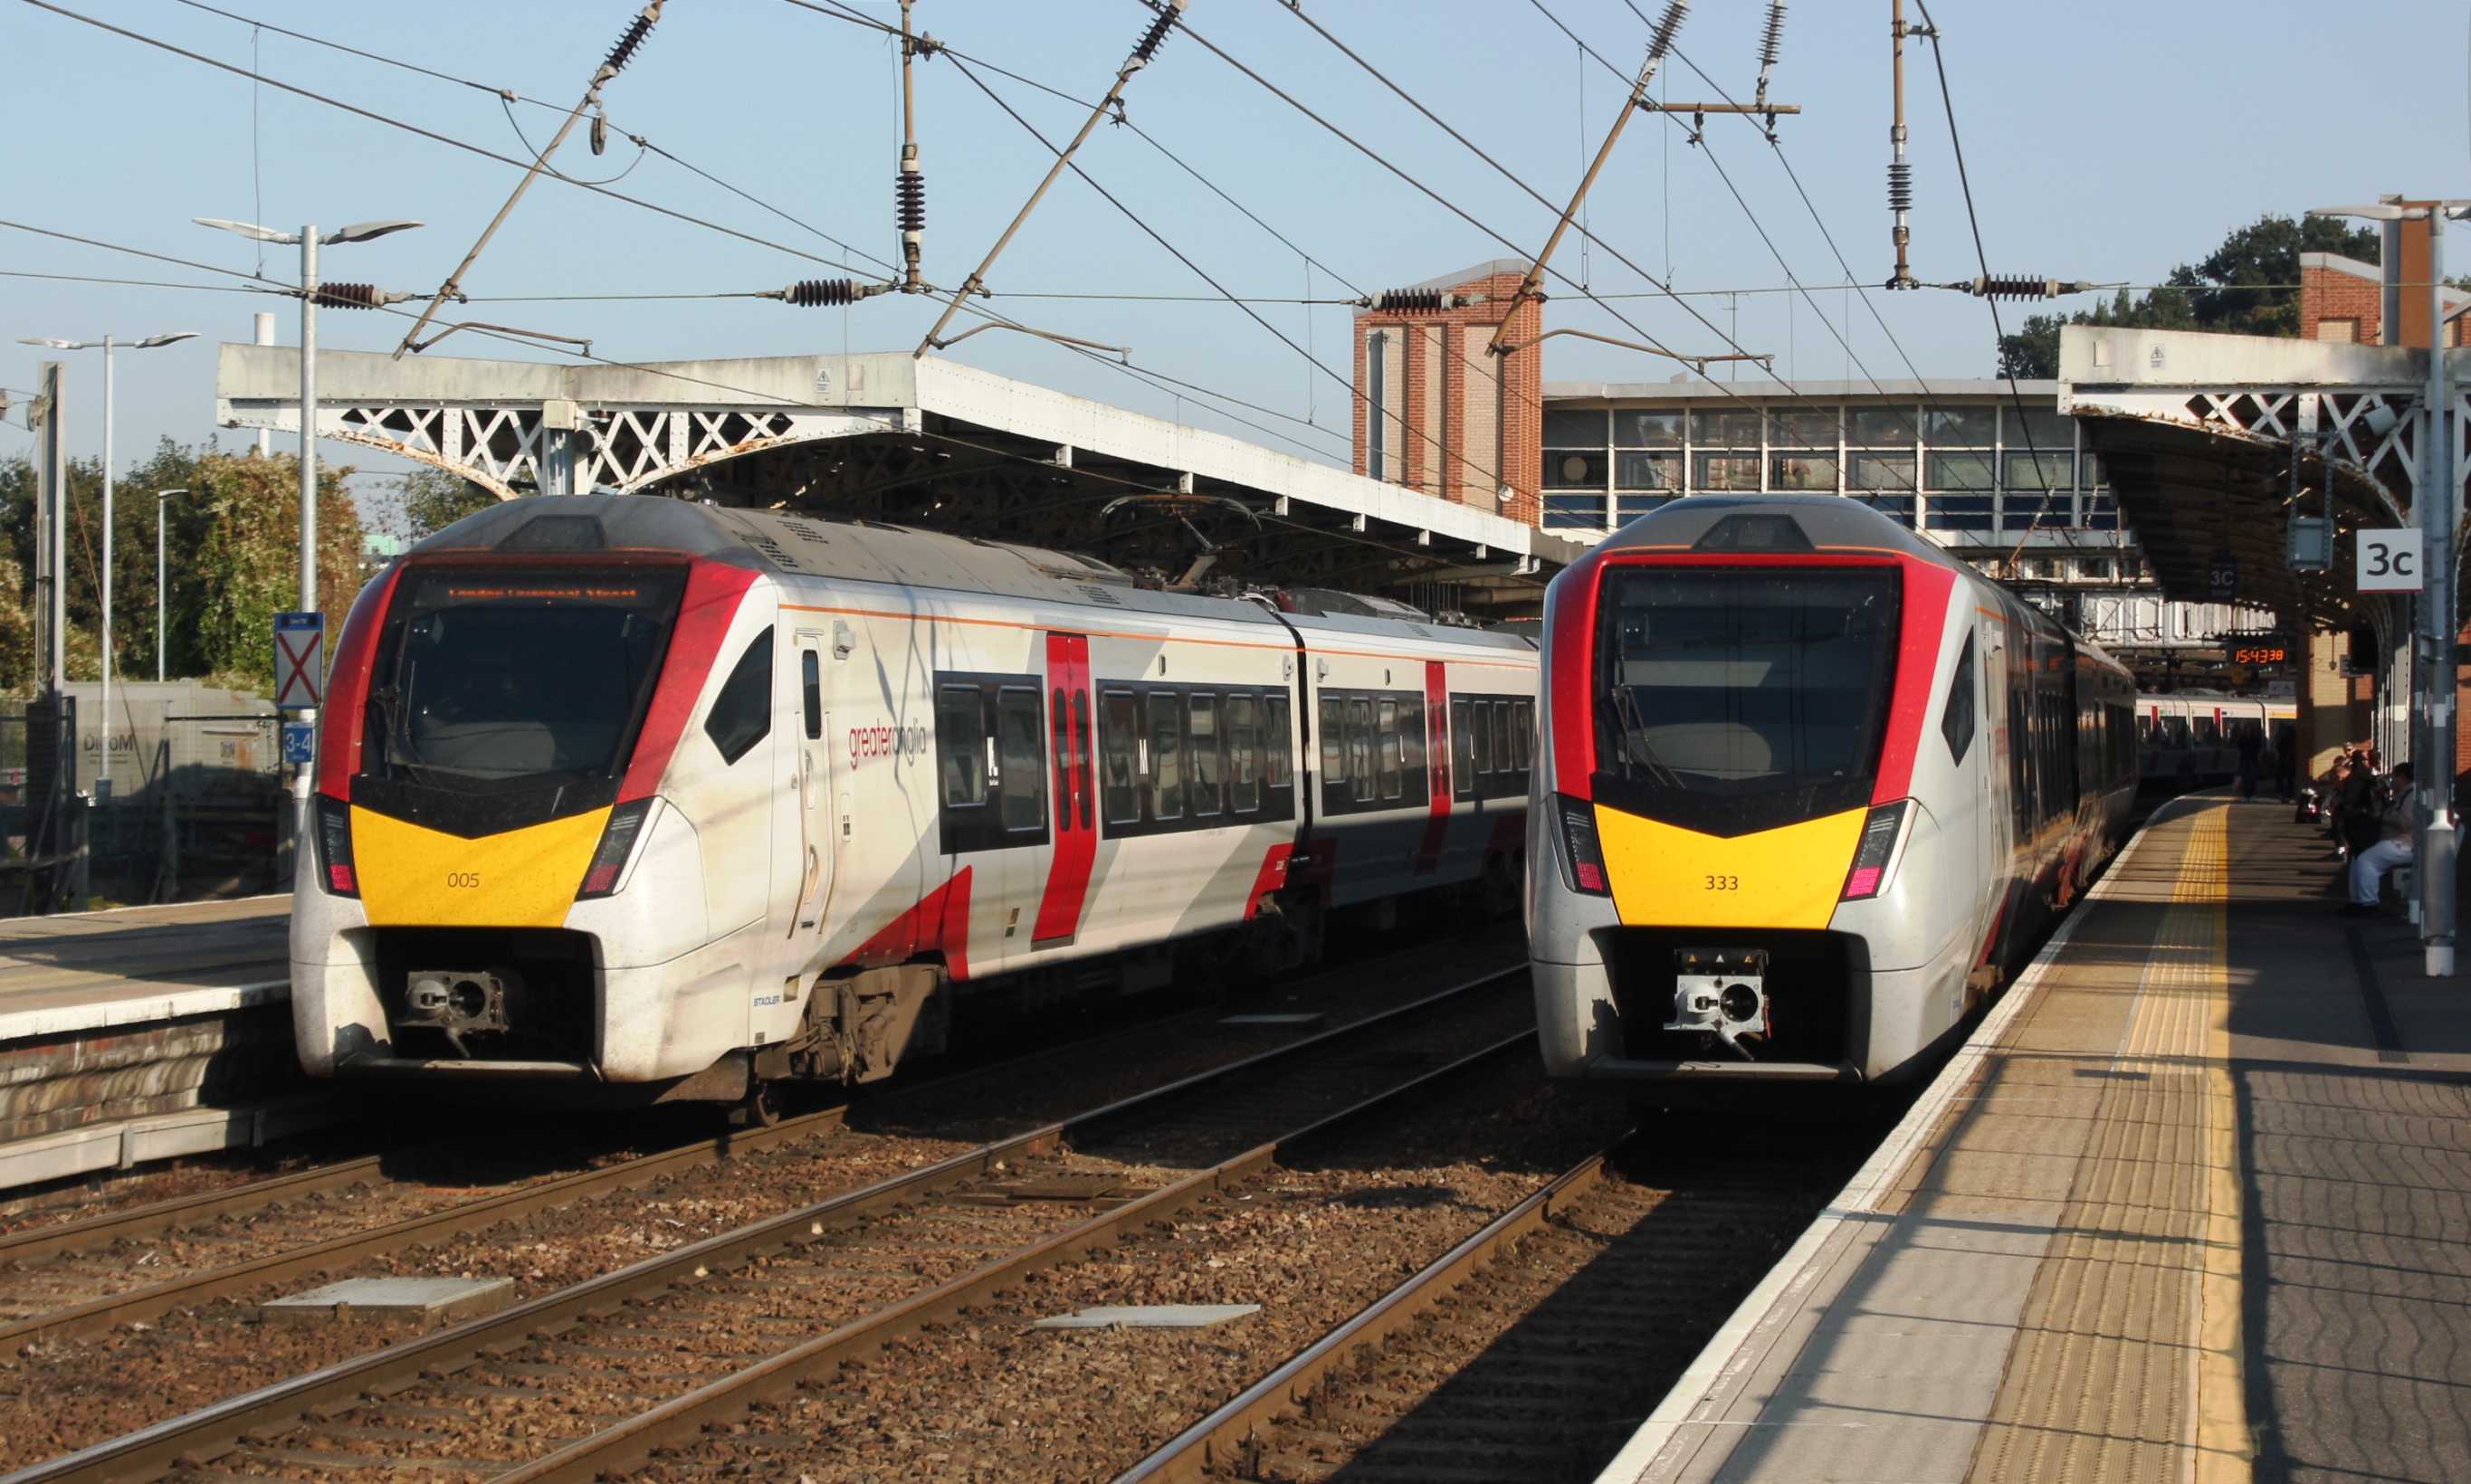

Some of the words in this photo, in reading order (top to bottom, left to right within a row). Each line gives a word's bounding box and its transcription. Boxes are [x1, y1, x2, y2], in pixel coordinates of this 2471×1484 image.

[2366, 543, 2413, 576] 3c
[2210, 570, 2234, 585] 3C
[286, 733, 311, 753] 3-4
[849, 718, 927, 771] greateranglia
[447, 872, 480, 889] 005
[1704, 875, 1739, 891] 333
